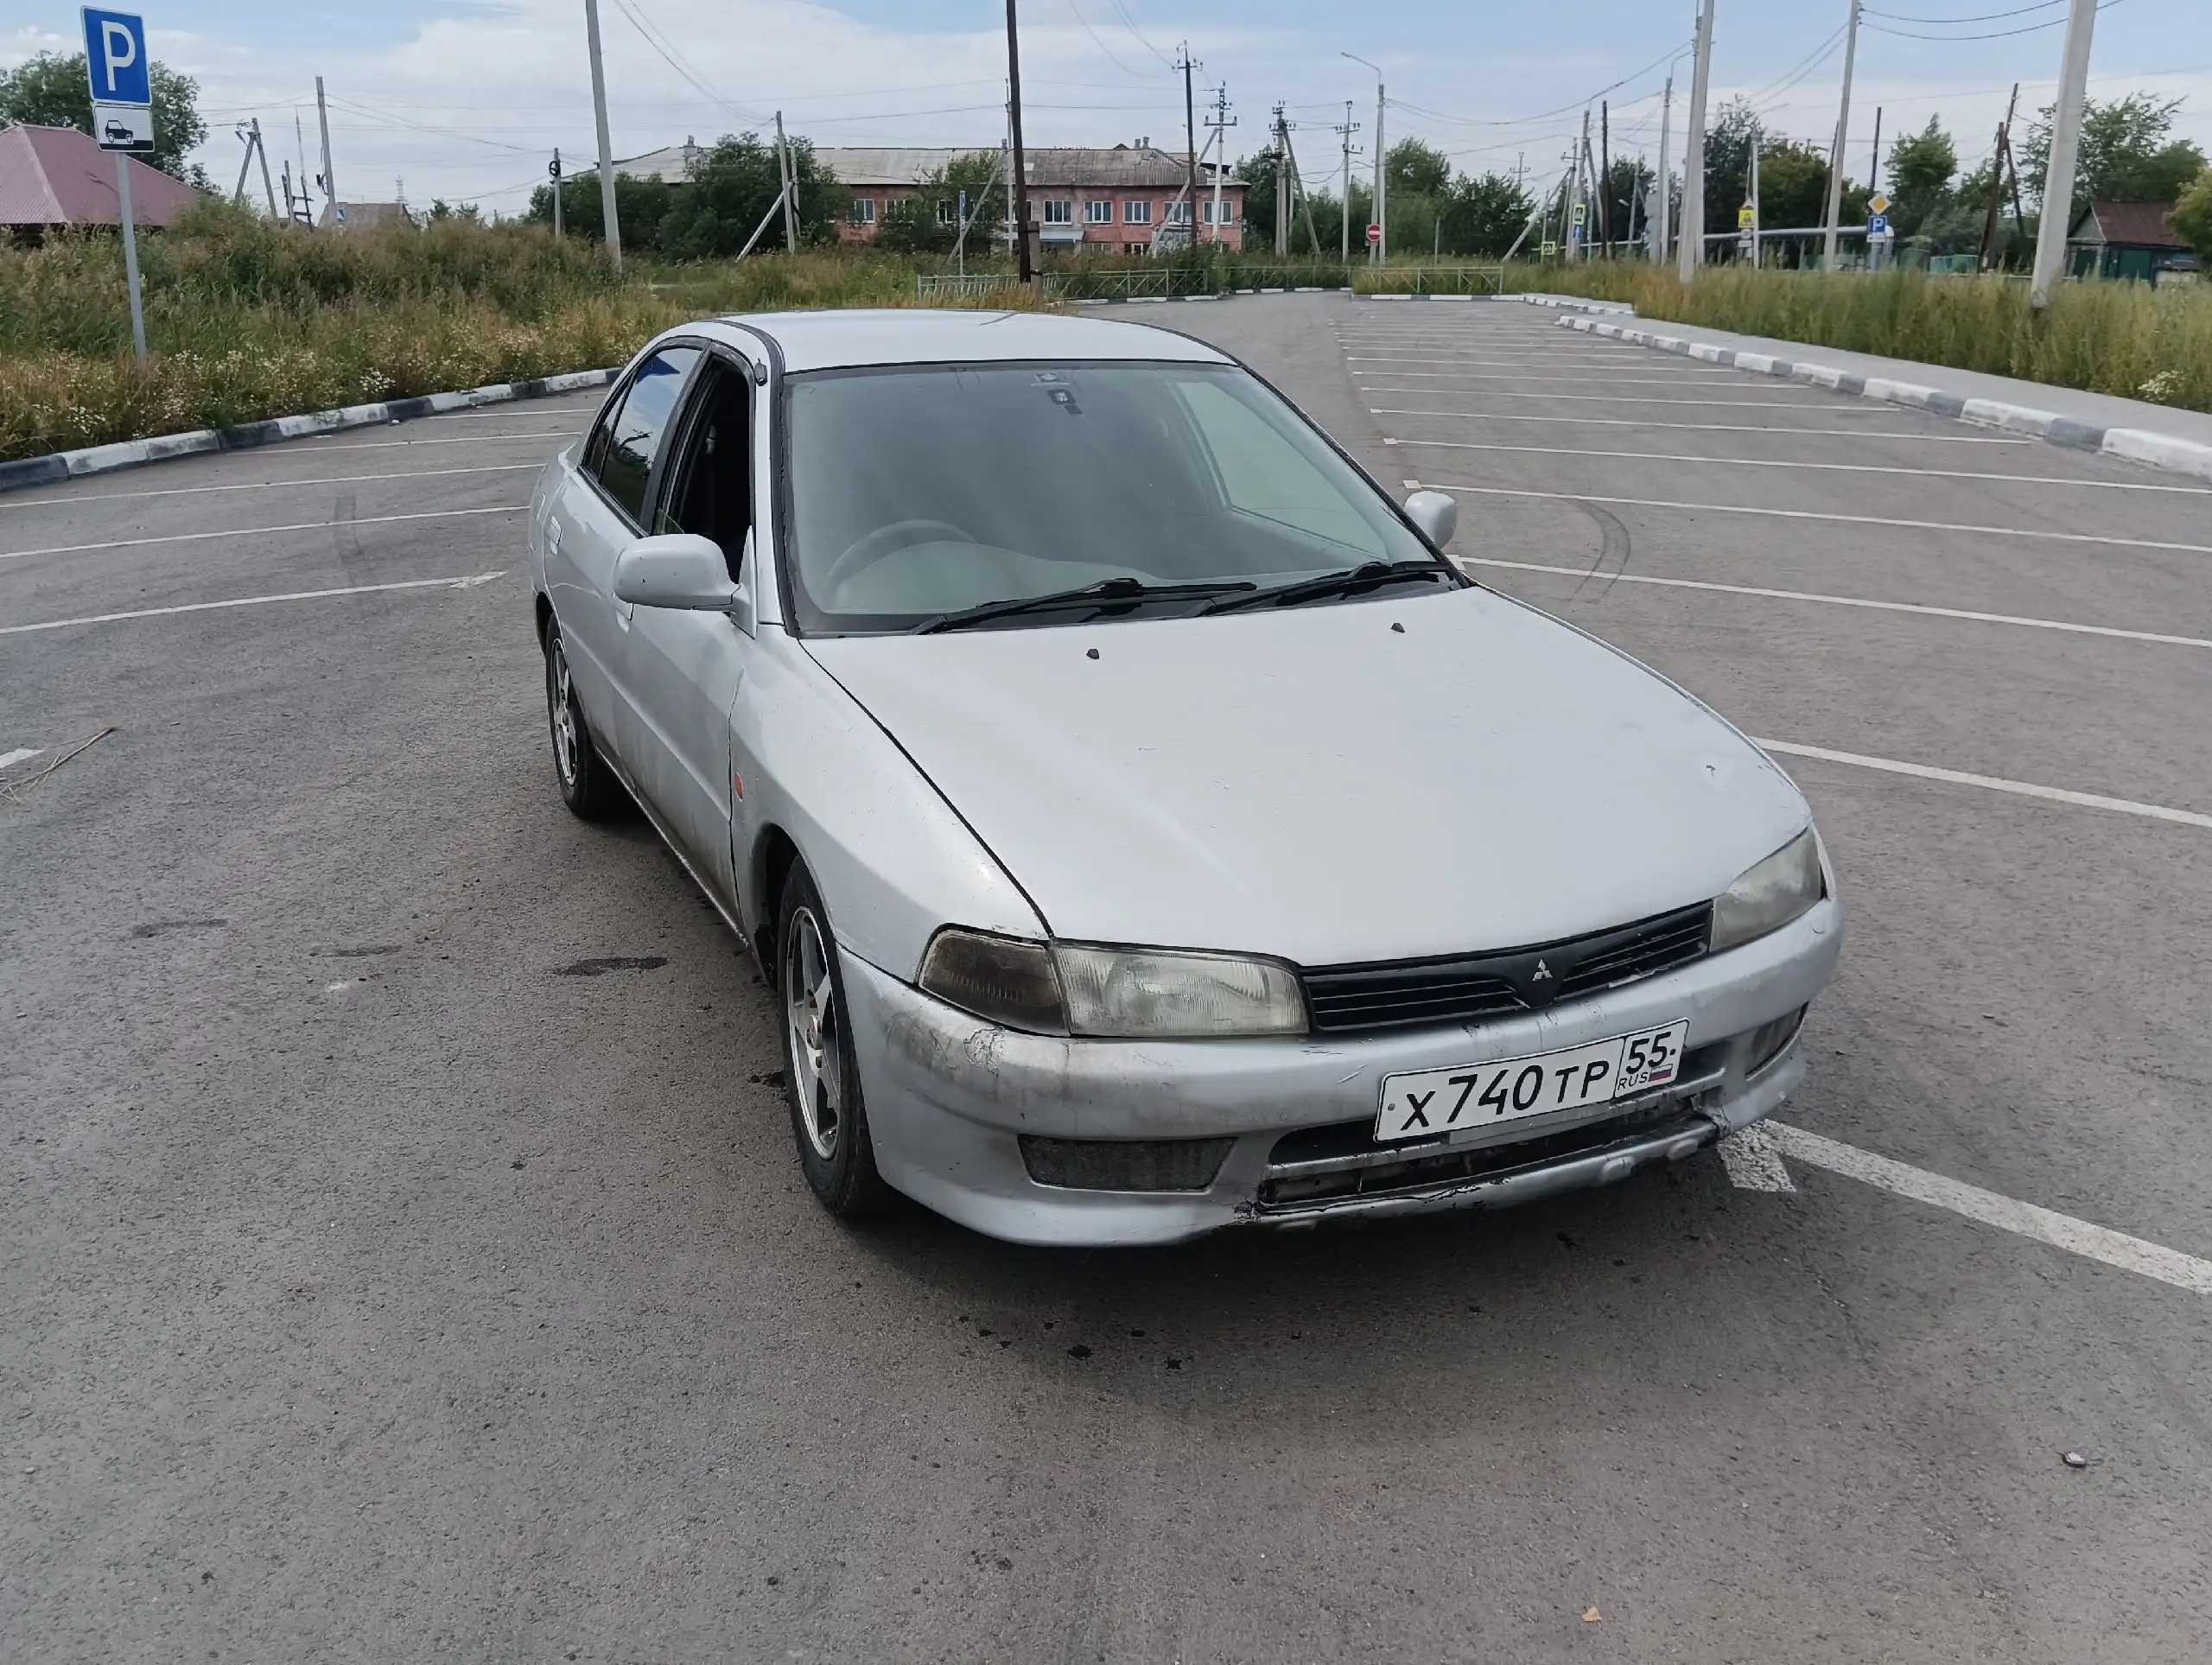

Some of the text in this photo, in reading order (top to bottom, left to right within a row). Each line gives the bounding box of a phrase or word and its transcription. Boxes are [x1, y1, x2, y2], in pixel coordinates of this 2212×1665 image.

[101, 21, 136, 92] P
[1872, 218, 1884, 232] P
[1625, 1031, 1671, 1074] 55
[1618, 1071, 1649, 1090] RUS
